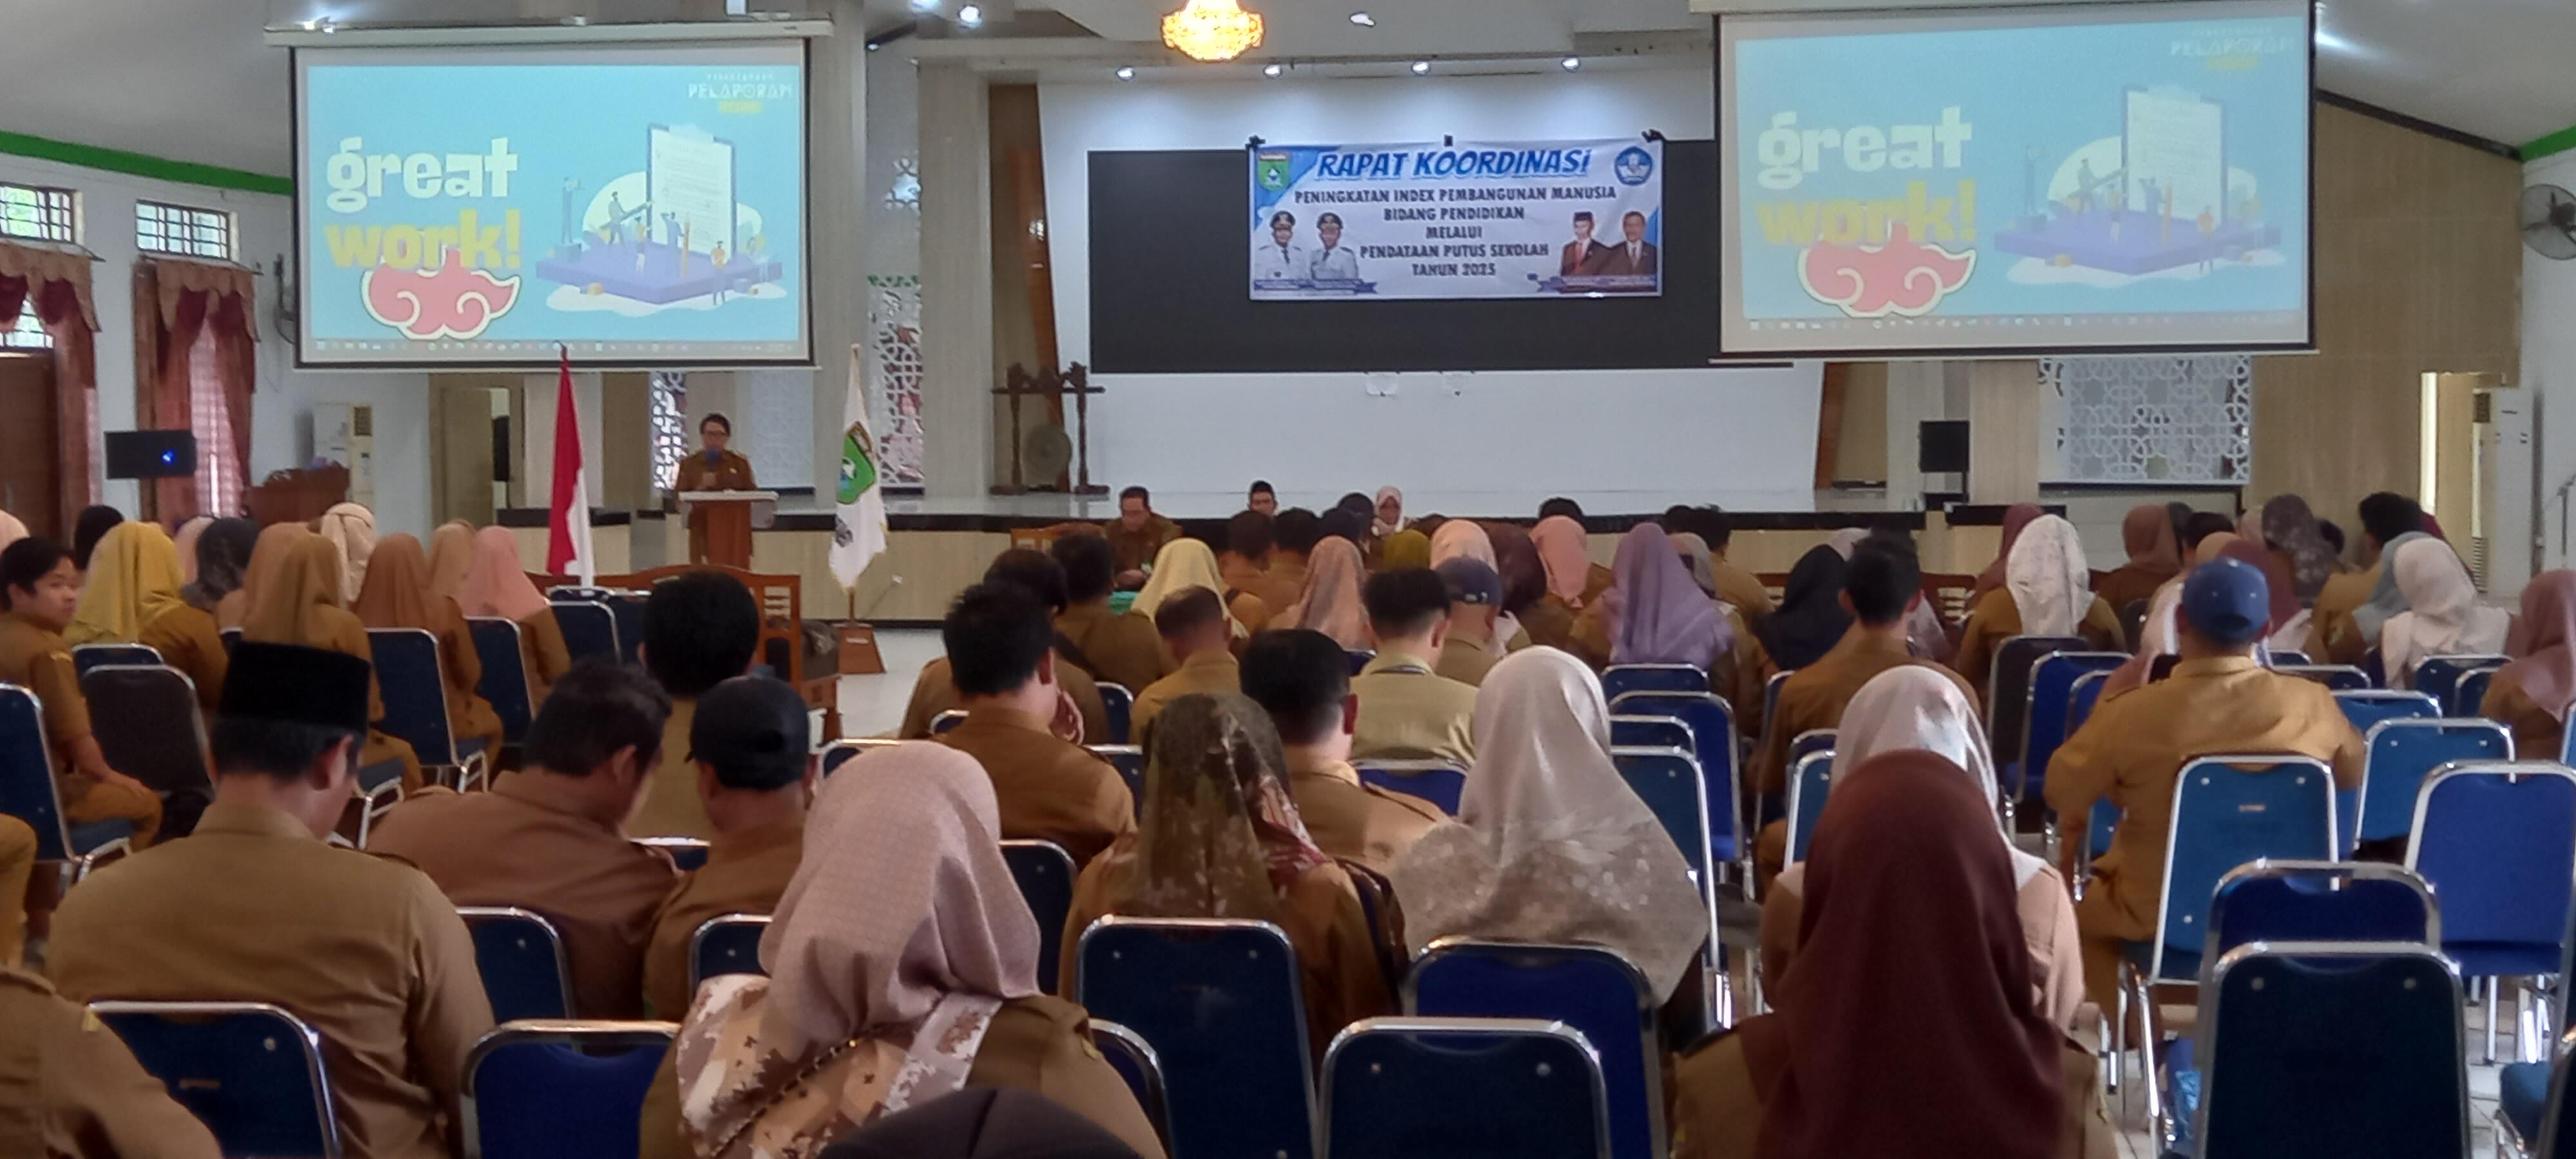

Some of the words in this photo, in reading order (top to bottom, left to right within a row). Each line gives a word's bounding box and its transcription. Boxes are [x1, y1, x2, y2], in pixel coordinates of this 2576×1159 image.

[688, 83, 793, 98] PELAPORAN
[1757, 106, 1973, 189] great
[326, 137, 518, 213] great
[1317, 153, 1408, 177] RAPAT
[1294, 189, 1390, 204] PENINGKATAN
[1394, 189, 1435, 202] INDEX
[1439, 187, 1546, 202] PEMBANGUNAN
[1551, 186, 1616, 199] MANUSIA
[1383, 208, 1436, 221] BIDANG
[1440, 207, 1524, 221] PENDIDIKAN
[1755, 178, 1976, 245] work!
[324, 209, 521, 269] work!
[1425, 226, 1482, 239] MELALUI
[1360, 245, 1439, 258] PENDATAAN
[1443, 245, 1486, 258] PUTUS
[1490, 243, 1549, 257] SEKOLAH
